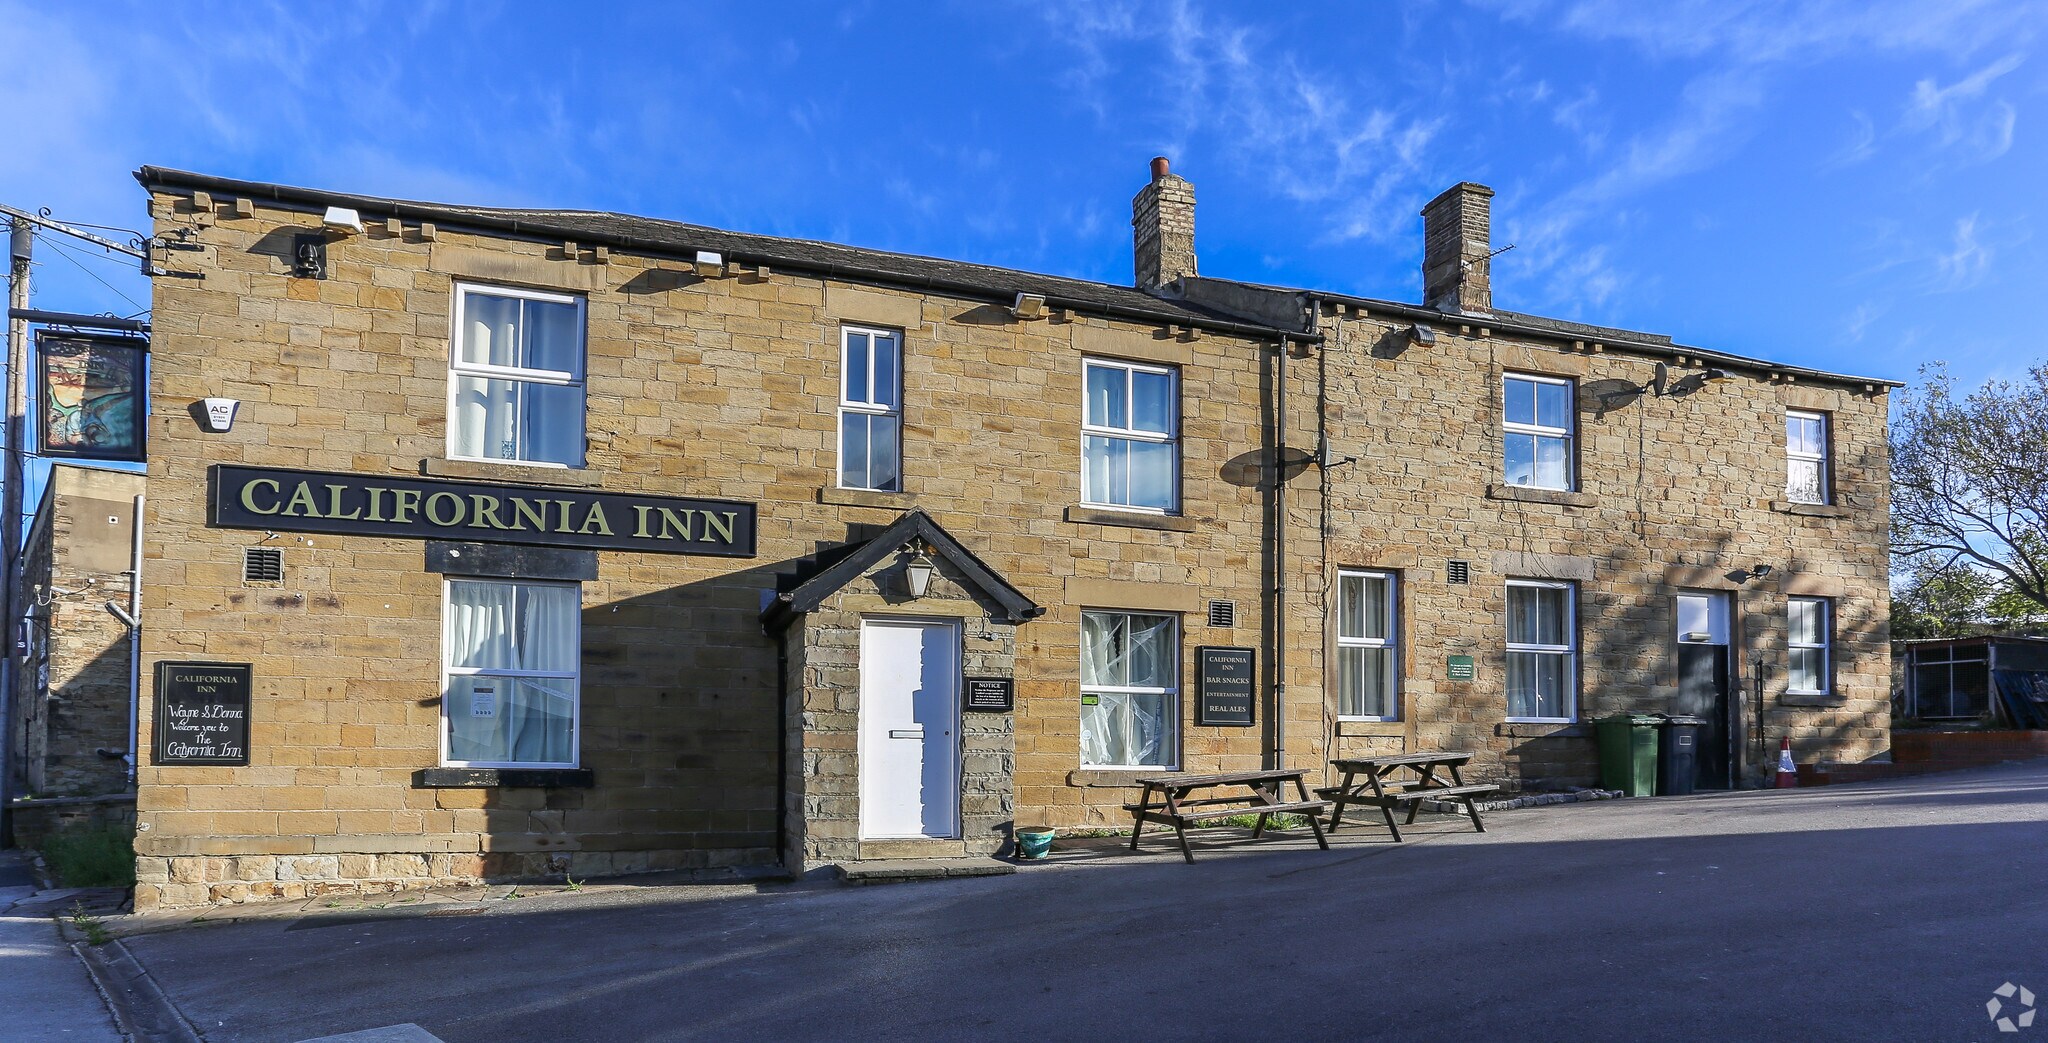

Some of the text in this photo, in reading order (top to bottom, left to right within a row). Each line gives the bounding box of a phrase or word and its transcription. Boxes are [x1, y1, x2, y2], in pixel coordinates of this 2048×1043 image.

[210, 405, 228, 413] AC
[241, 478, 737, 544] CALIFORNIA INN
[175, 675, 238, 684] CALIFORNIA
[197, 685, 216, 693] INN
[168, 705, 199, 726] Wayne
[211, 705, 243, 718] Donna
[170, 721, 229, 736] Welcome you to
[195, 734, 211, 744] The
[167, 741, 243, 758] California Inn
